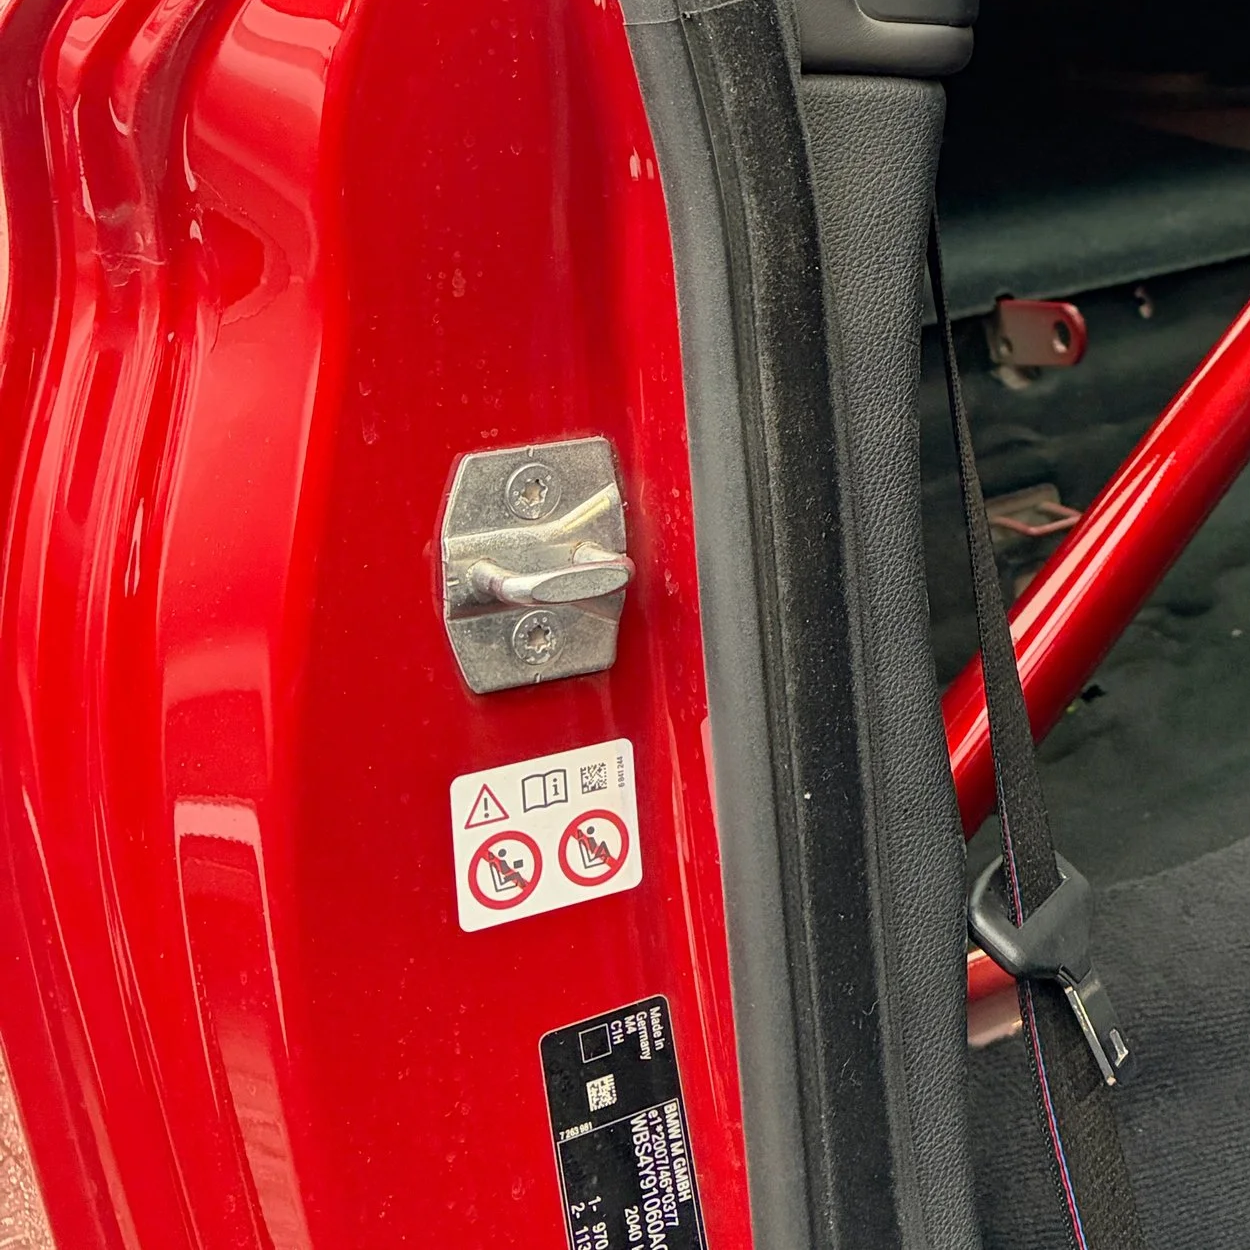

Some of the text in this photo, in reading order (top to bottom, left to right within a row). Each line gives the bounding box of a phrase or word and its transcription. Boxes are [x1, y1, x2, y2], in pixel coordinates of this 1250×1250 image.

[610, 1020, 625, 1045] C1H
[624, 1014, 637, 1035] M4
[636, 1011, 652, 1060] Germany
[649, 1006, 664, 1038] Made
[663, 1102, 692, 1204] BMW M GMBH
[592, 1221, 609, 1250] 970
[624, 1205, 643, 1242] 2040
